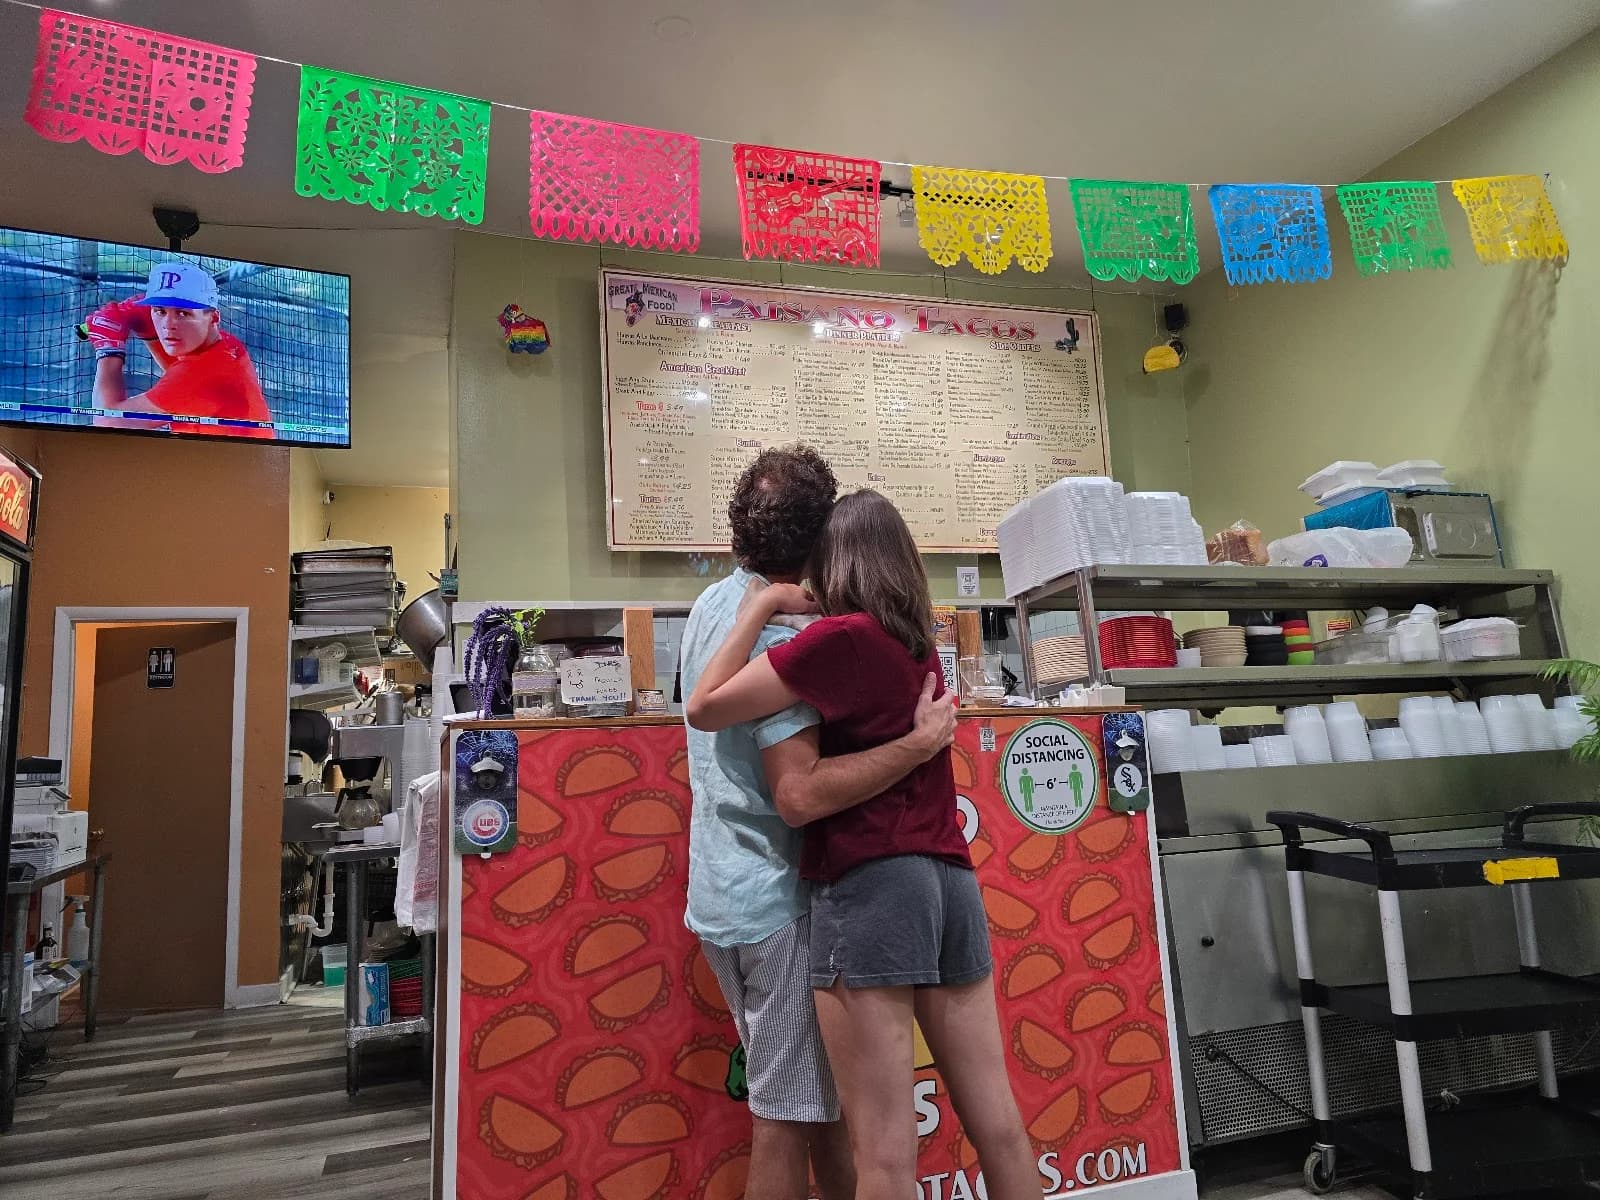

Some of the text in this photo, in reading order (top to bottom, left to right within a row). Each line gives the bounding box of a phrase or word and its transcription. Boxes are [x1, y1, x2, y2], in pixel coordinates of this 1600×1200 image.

[642, 282, 679, 304] MEXICAN
[697, 287, 1038, 342] PAISANO TACOS
[701, 316, 752, 333] REAKFAST
[989, 340, 1009, 351] SIDE
[659, 360, 747, 377] American Breakfast
[569, 695, 597, 703] THANK
[1025, 734, 1069, 749] SOCIAL
[1011, 748, 1085, 765] DISTANCING
[1046, 777, 1057, 790] 6'
